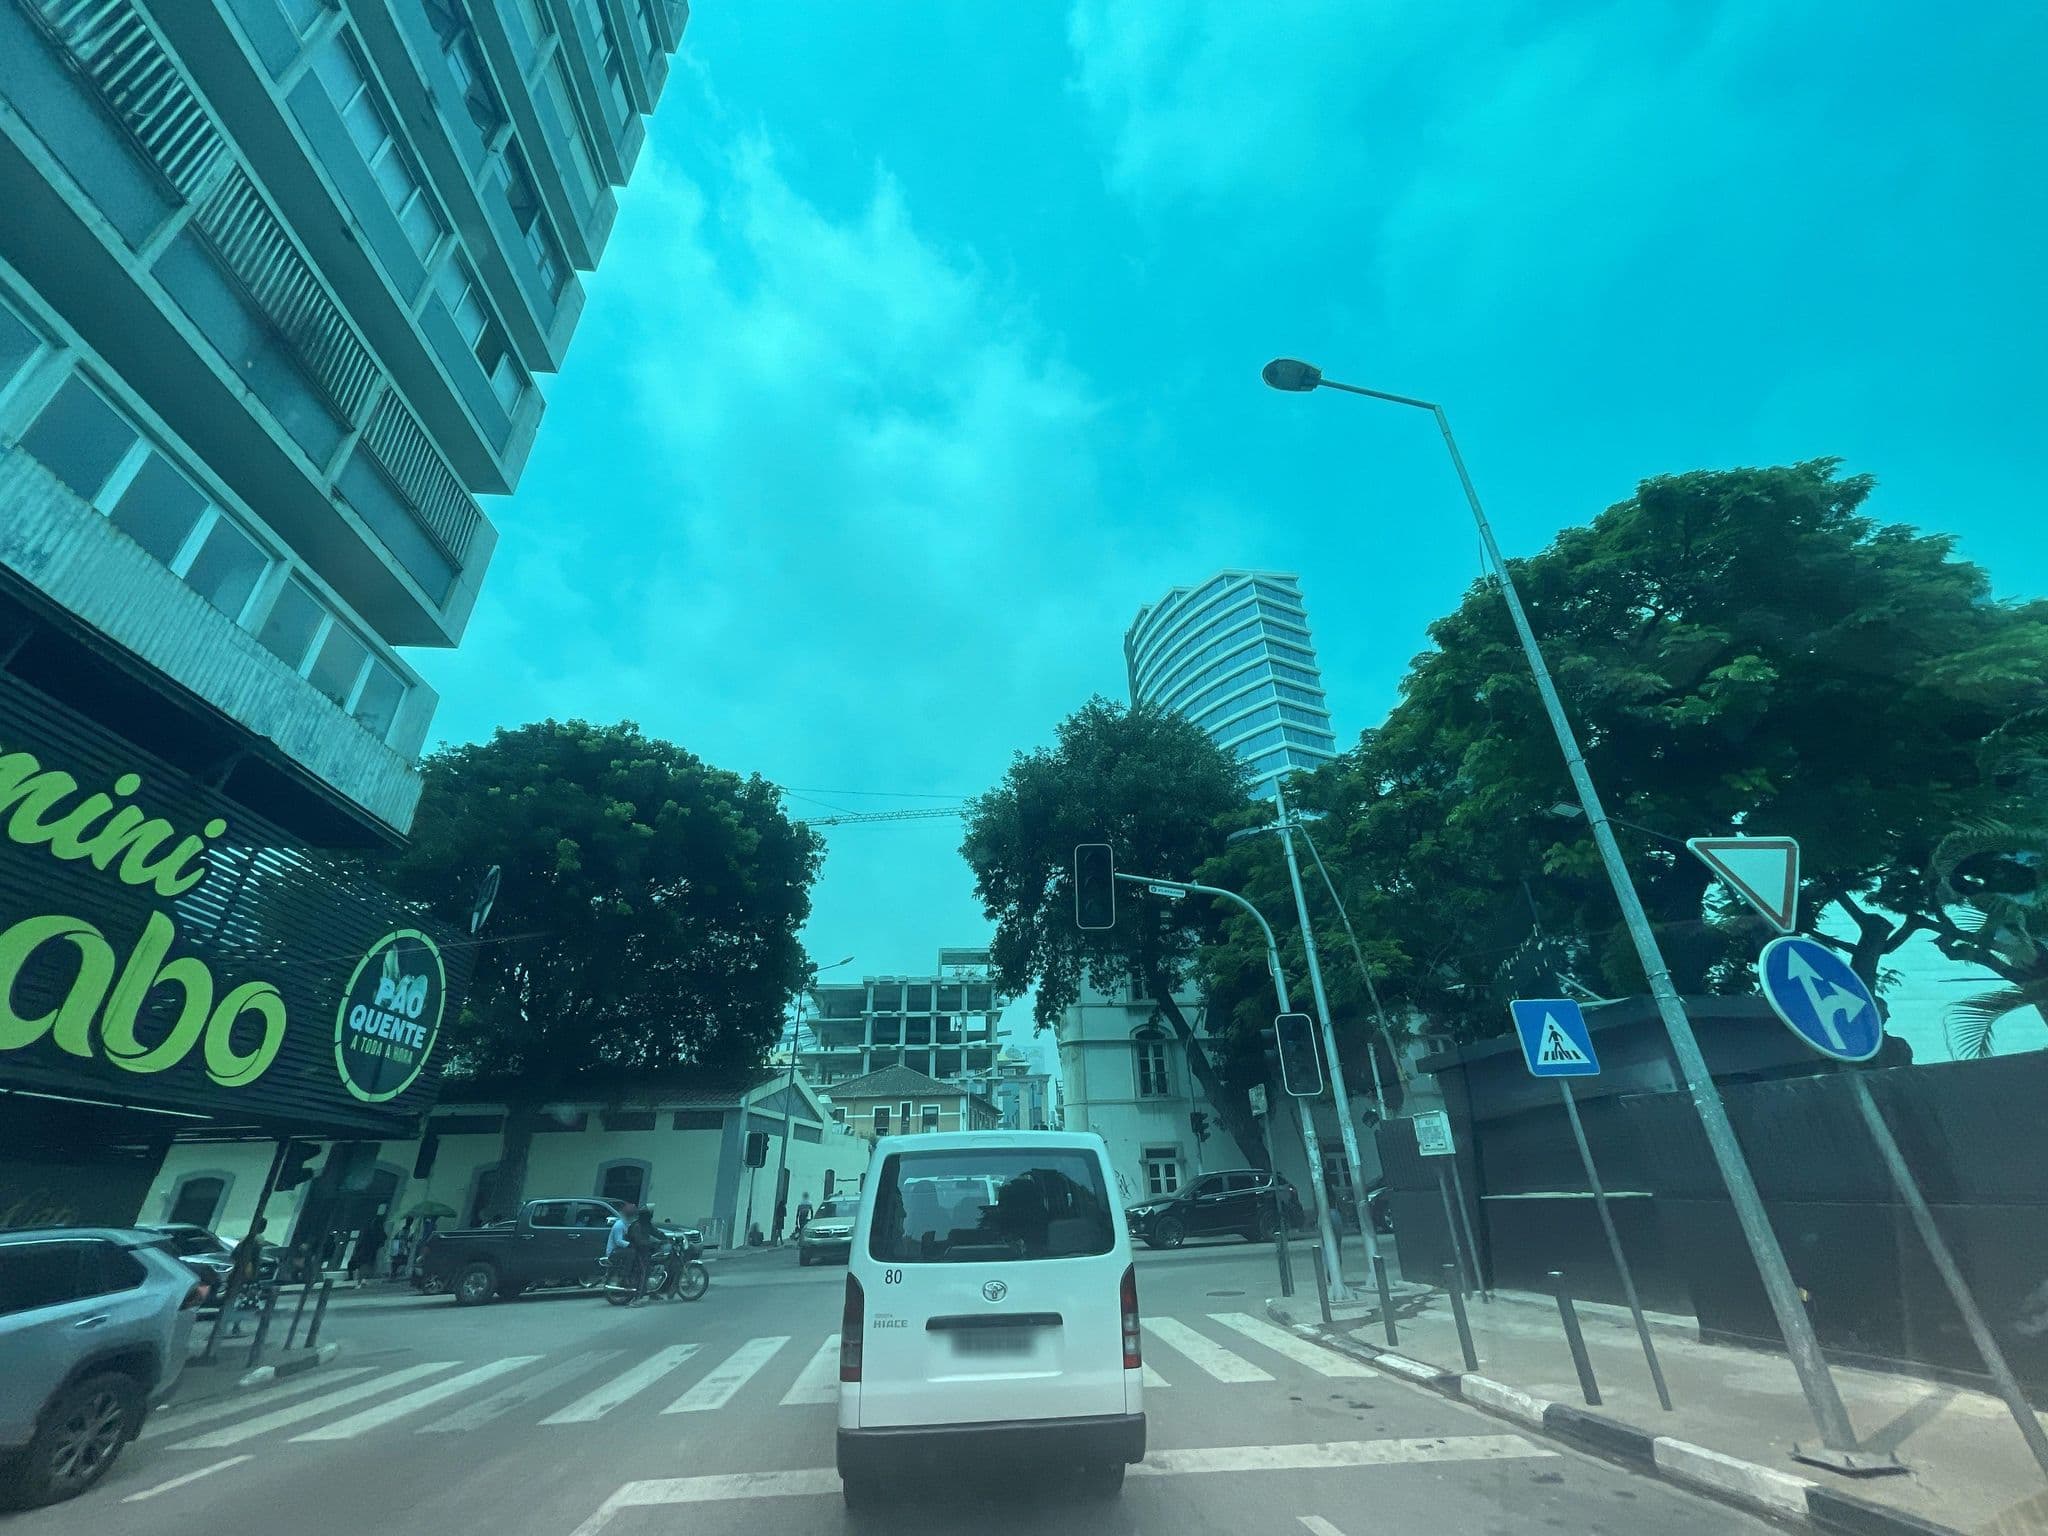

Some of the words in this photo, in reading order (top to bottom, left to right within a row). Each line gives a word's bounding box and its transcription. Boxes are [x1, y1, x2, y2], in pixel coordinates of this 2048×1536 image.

[350, 1004, 427, 1049] QUENTE
[885, 1269, 902, 1284] 80
[873, 1319, 908, 1328] HIACE
